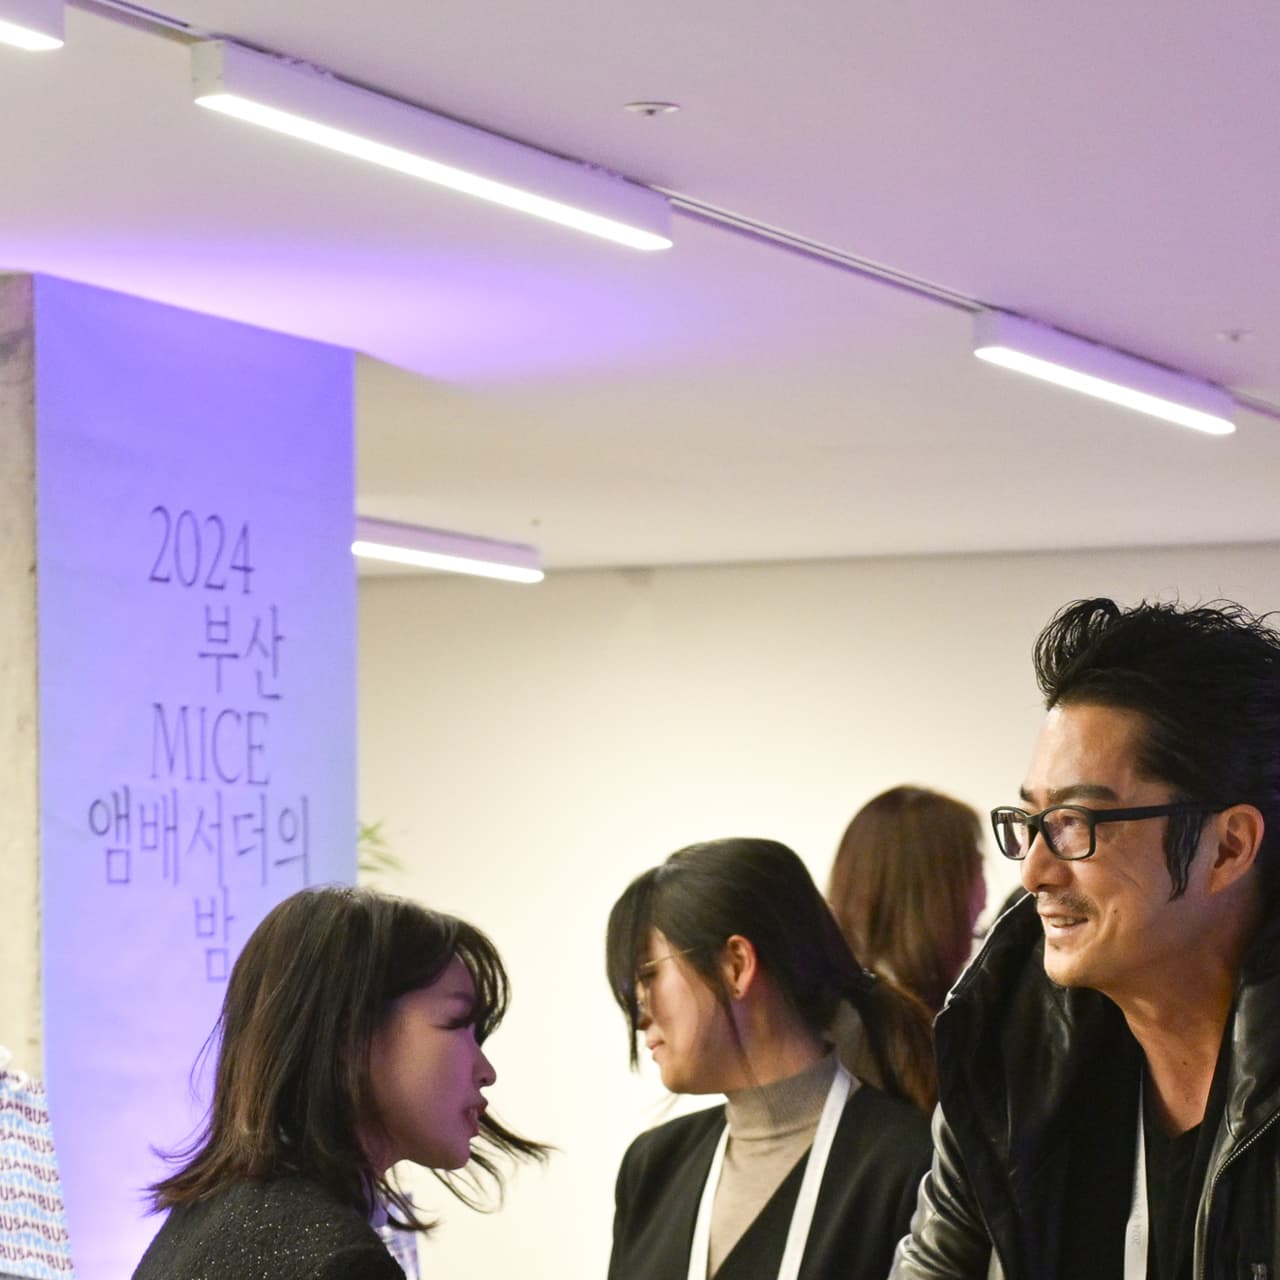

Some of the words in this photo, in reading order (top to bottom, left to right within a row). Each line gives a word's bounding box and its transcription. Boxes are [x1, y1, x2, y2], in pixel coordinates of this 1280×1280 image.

[147, 505, 256, 595] 2024
[197, 603, 286, 702] 부산
[148, 703, 272, 788] MICE
[88, 784, 312, 888] 앰배서더의
[193, 886, 237, 985] 밤
